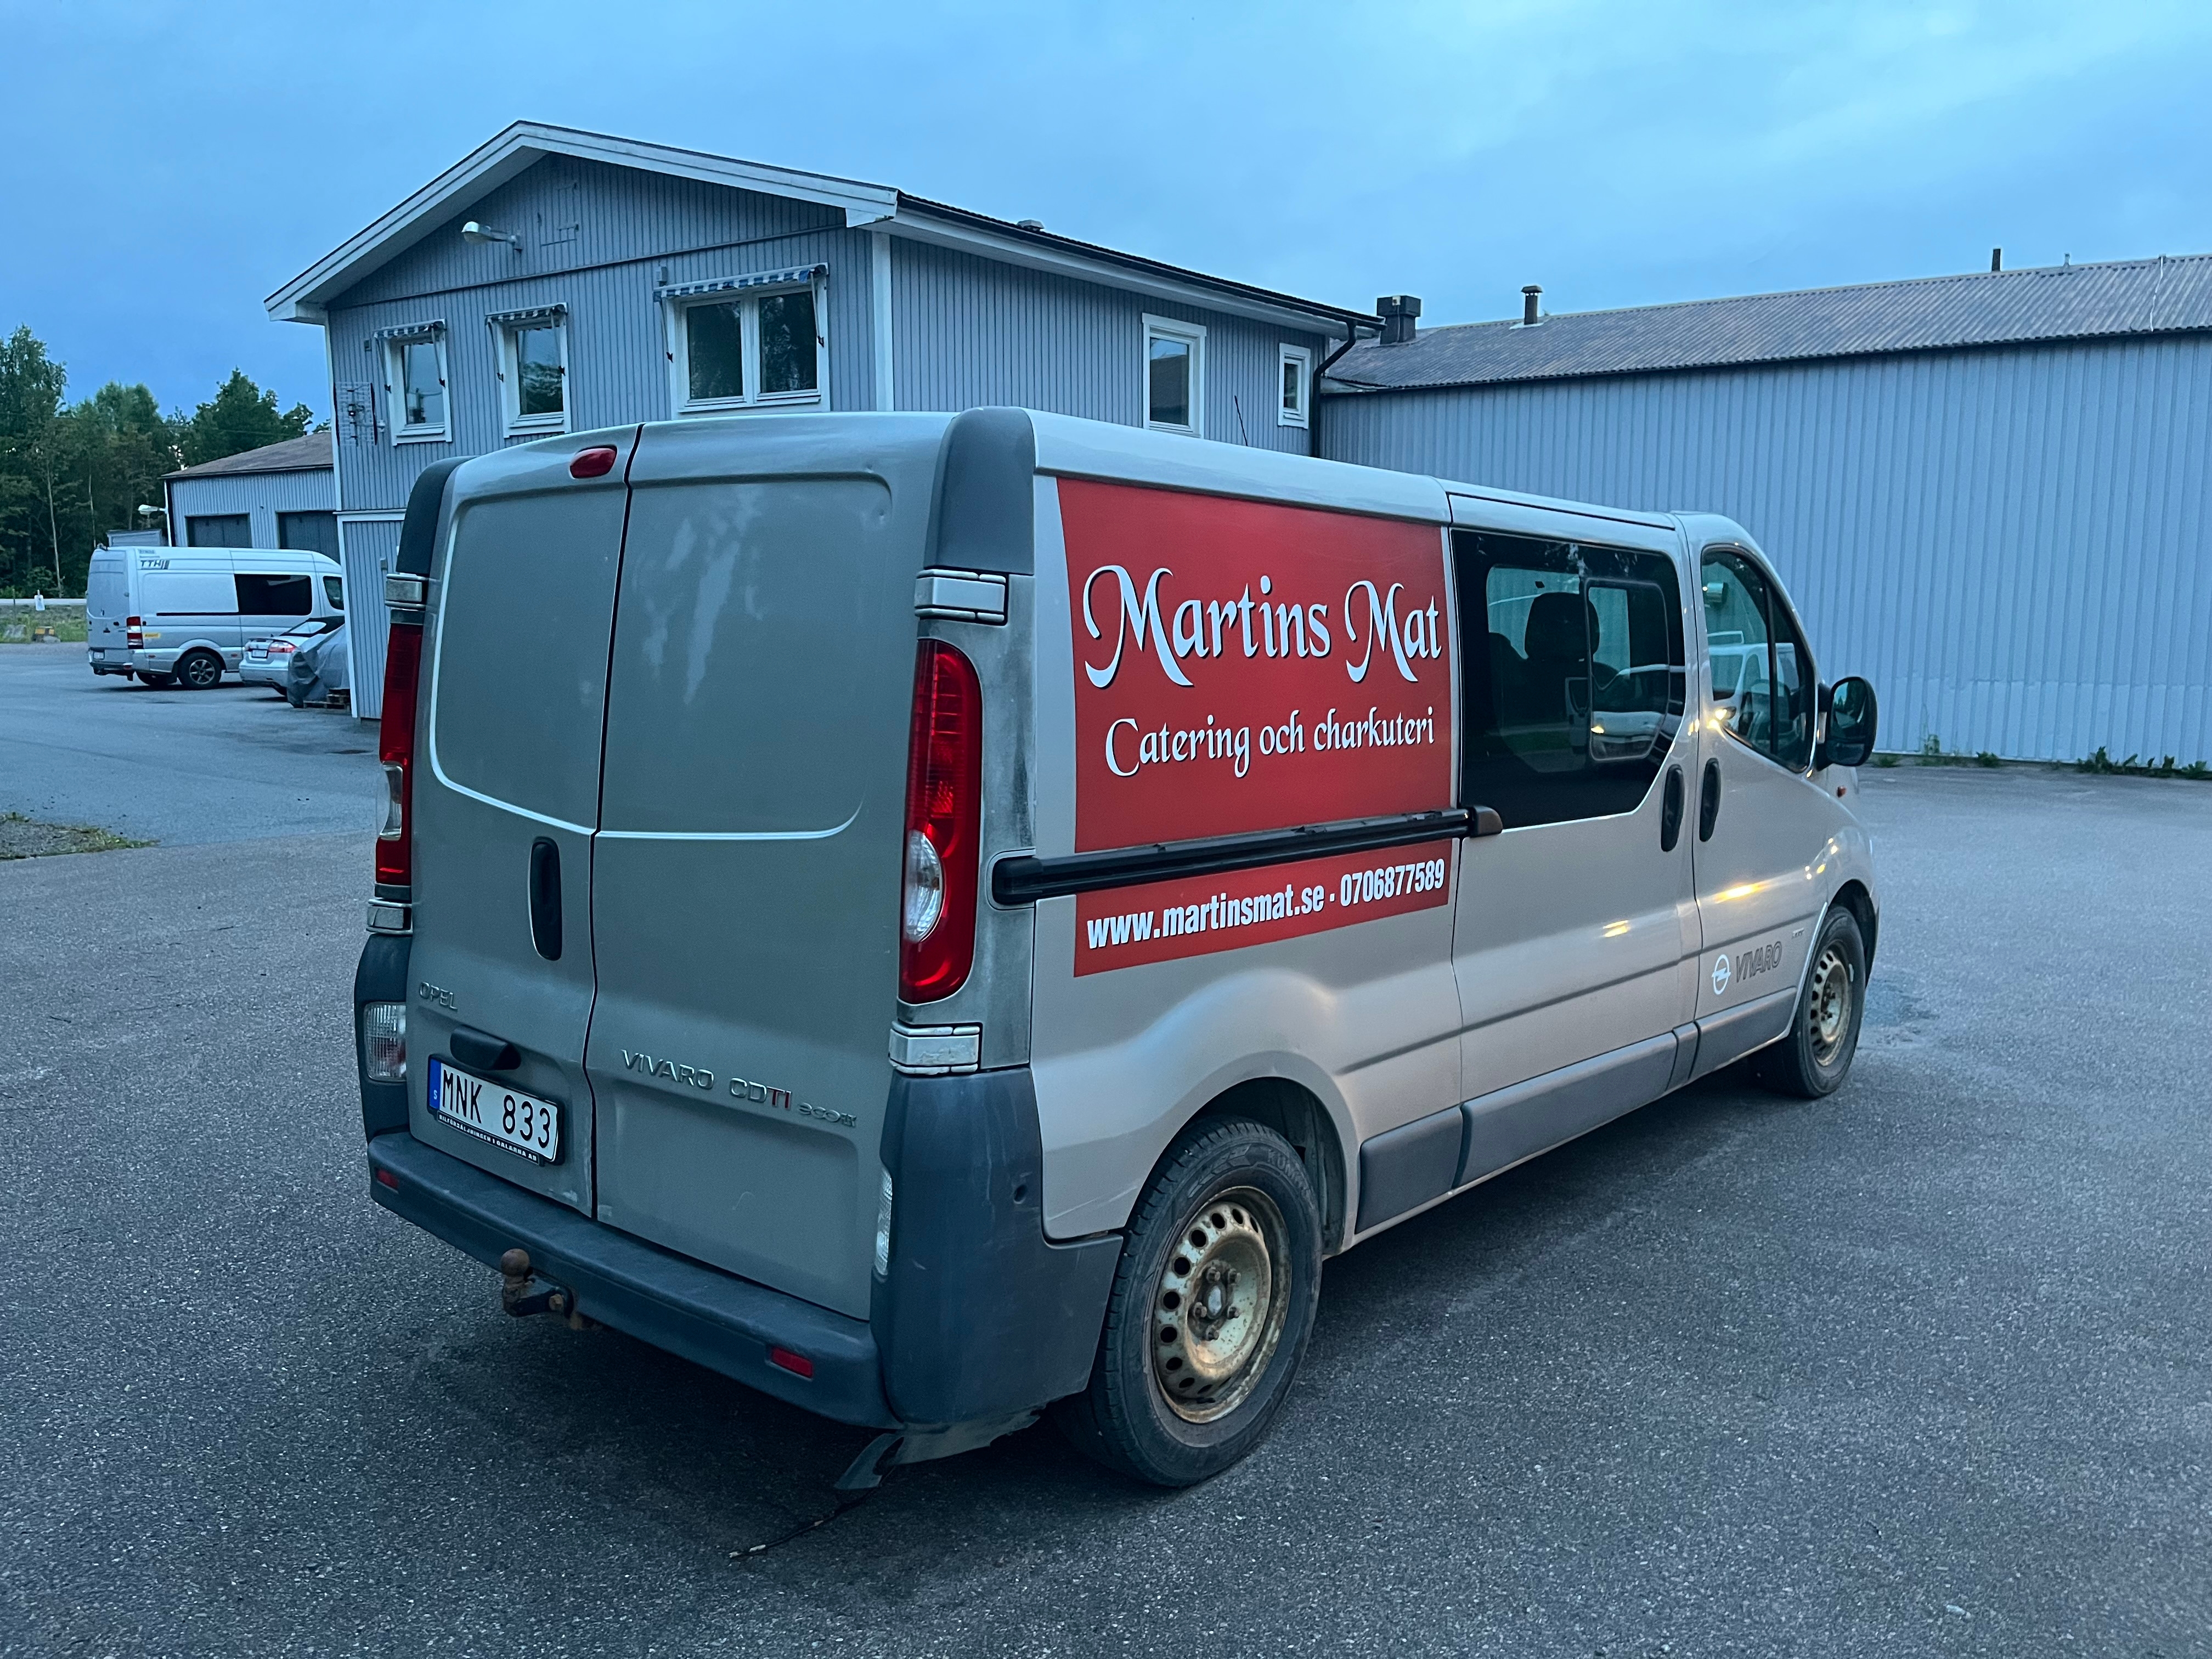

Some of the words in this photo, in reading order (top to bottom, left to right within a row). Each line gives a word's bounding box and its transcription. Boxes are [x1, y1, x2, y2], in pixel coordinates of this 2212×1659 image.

[1083, 565, 1331, 688] Martins
[1344, 580, 1442, 682] Mat
[1105, 715, 1251, 778] Catering
[1259, 709, 1305, 755] och
[1313, 707, 1435, 751] charkuteri
[1087, 884, 1325, 949] www.martinsmat.se
[1340, 859, 1445, 907] 0706877589
[419, 981, 458, 1010] OPEL
[1735, 941, 1782, 983] VIVARO
[433, 1090, 438, 1100] S
[442, 1069, 483, 1124] MNK
[503, 1094, 551, 1149] 833
[620, 1049, 714, 1090] VIVARO
[729, 1077, 793, 1110] CDTI
